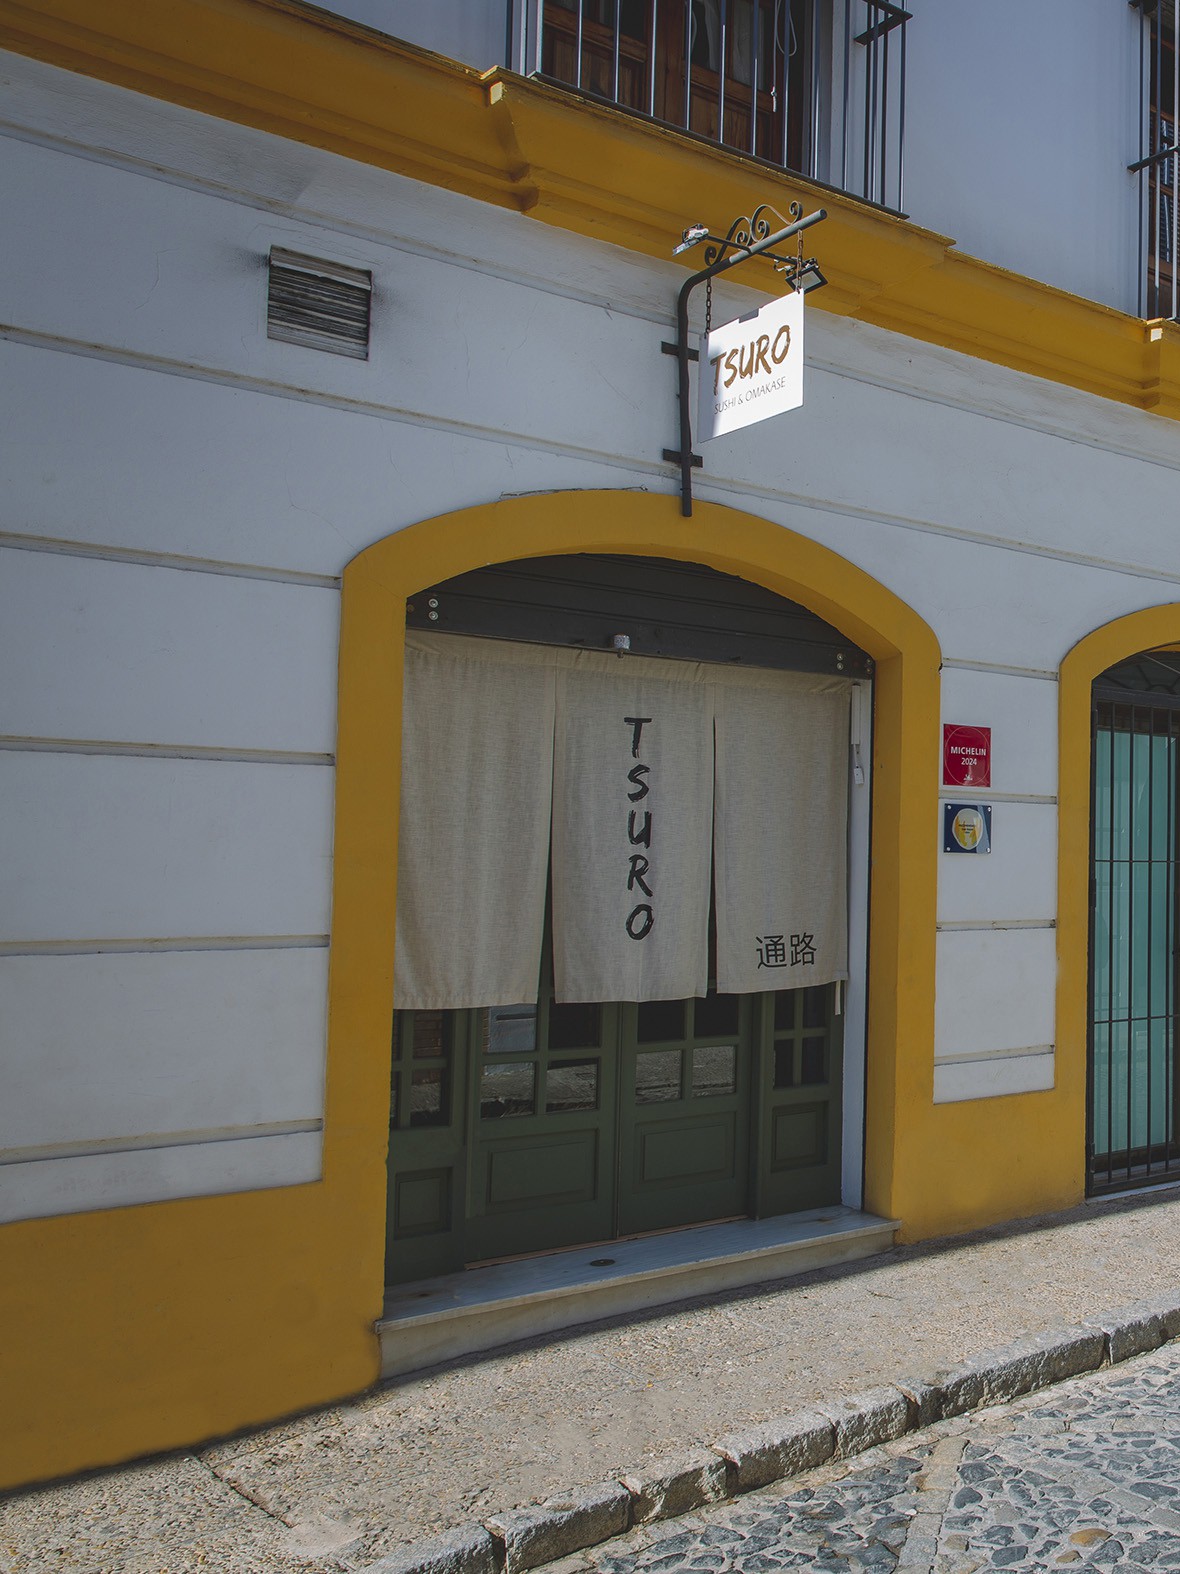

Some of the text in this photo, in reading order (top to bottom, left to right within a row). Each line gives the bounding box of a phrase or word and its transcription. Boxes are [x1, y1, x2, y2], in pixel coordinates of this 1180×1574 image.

[710, 324, 791, 396] TSURO
[714, 376, 786, 415] SUSHI & OMAKASE
[950, 746, 987, 756] MICHELIN
[961, 757, 977, 766] 2024
[623, 717, 655, 941] TSURO
[755, 932, 817, 969] 通路
